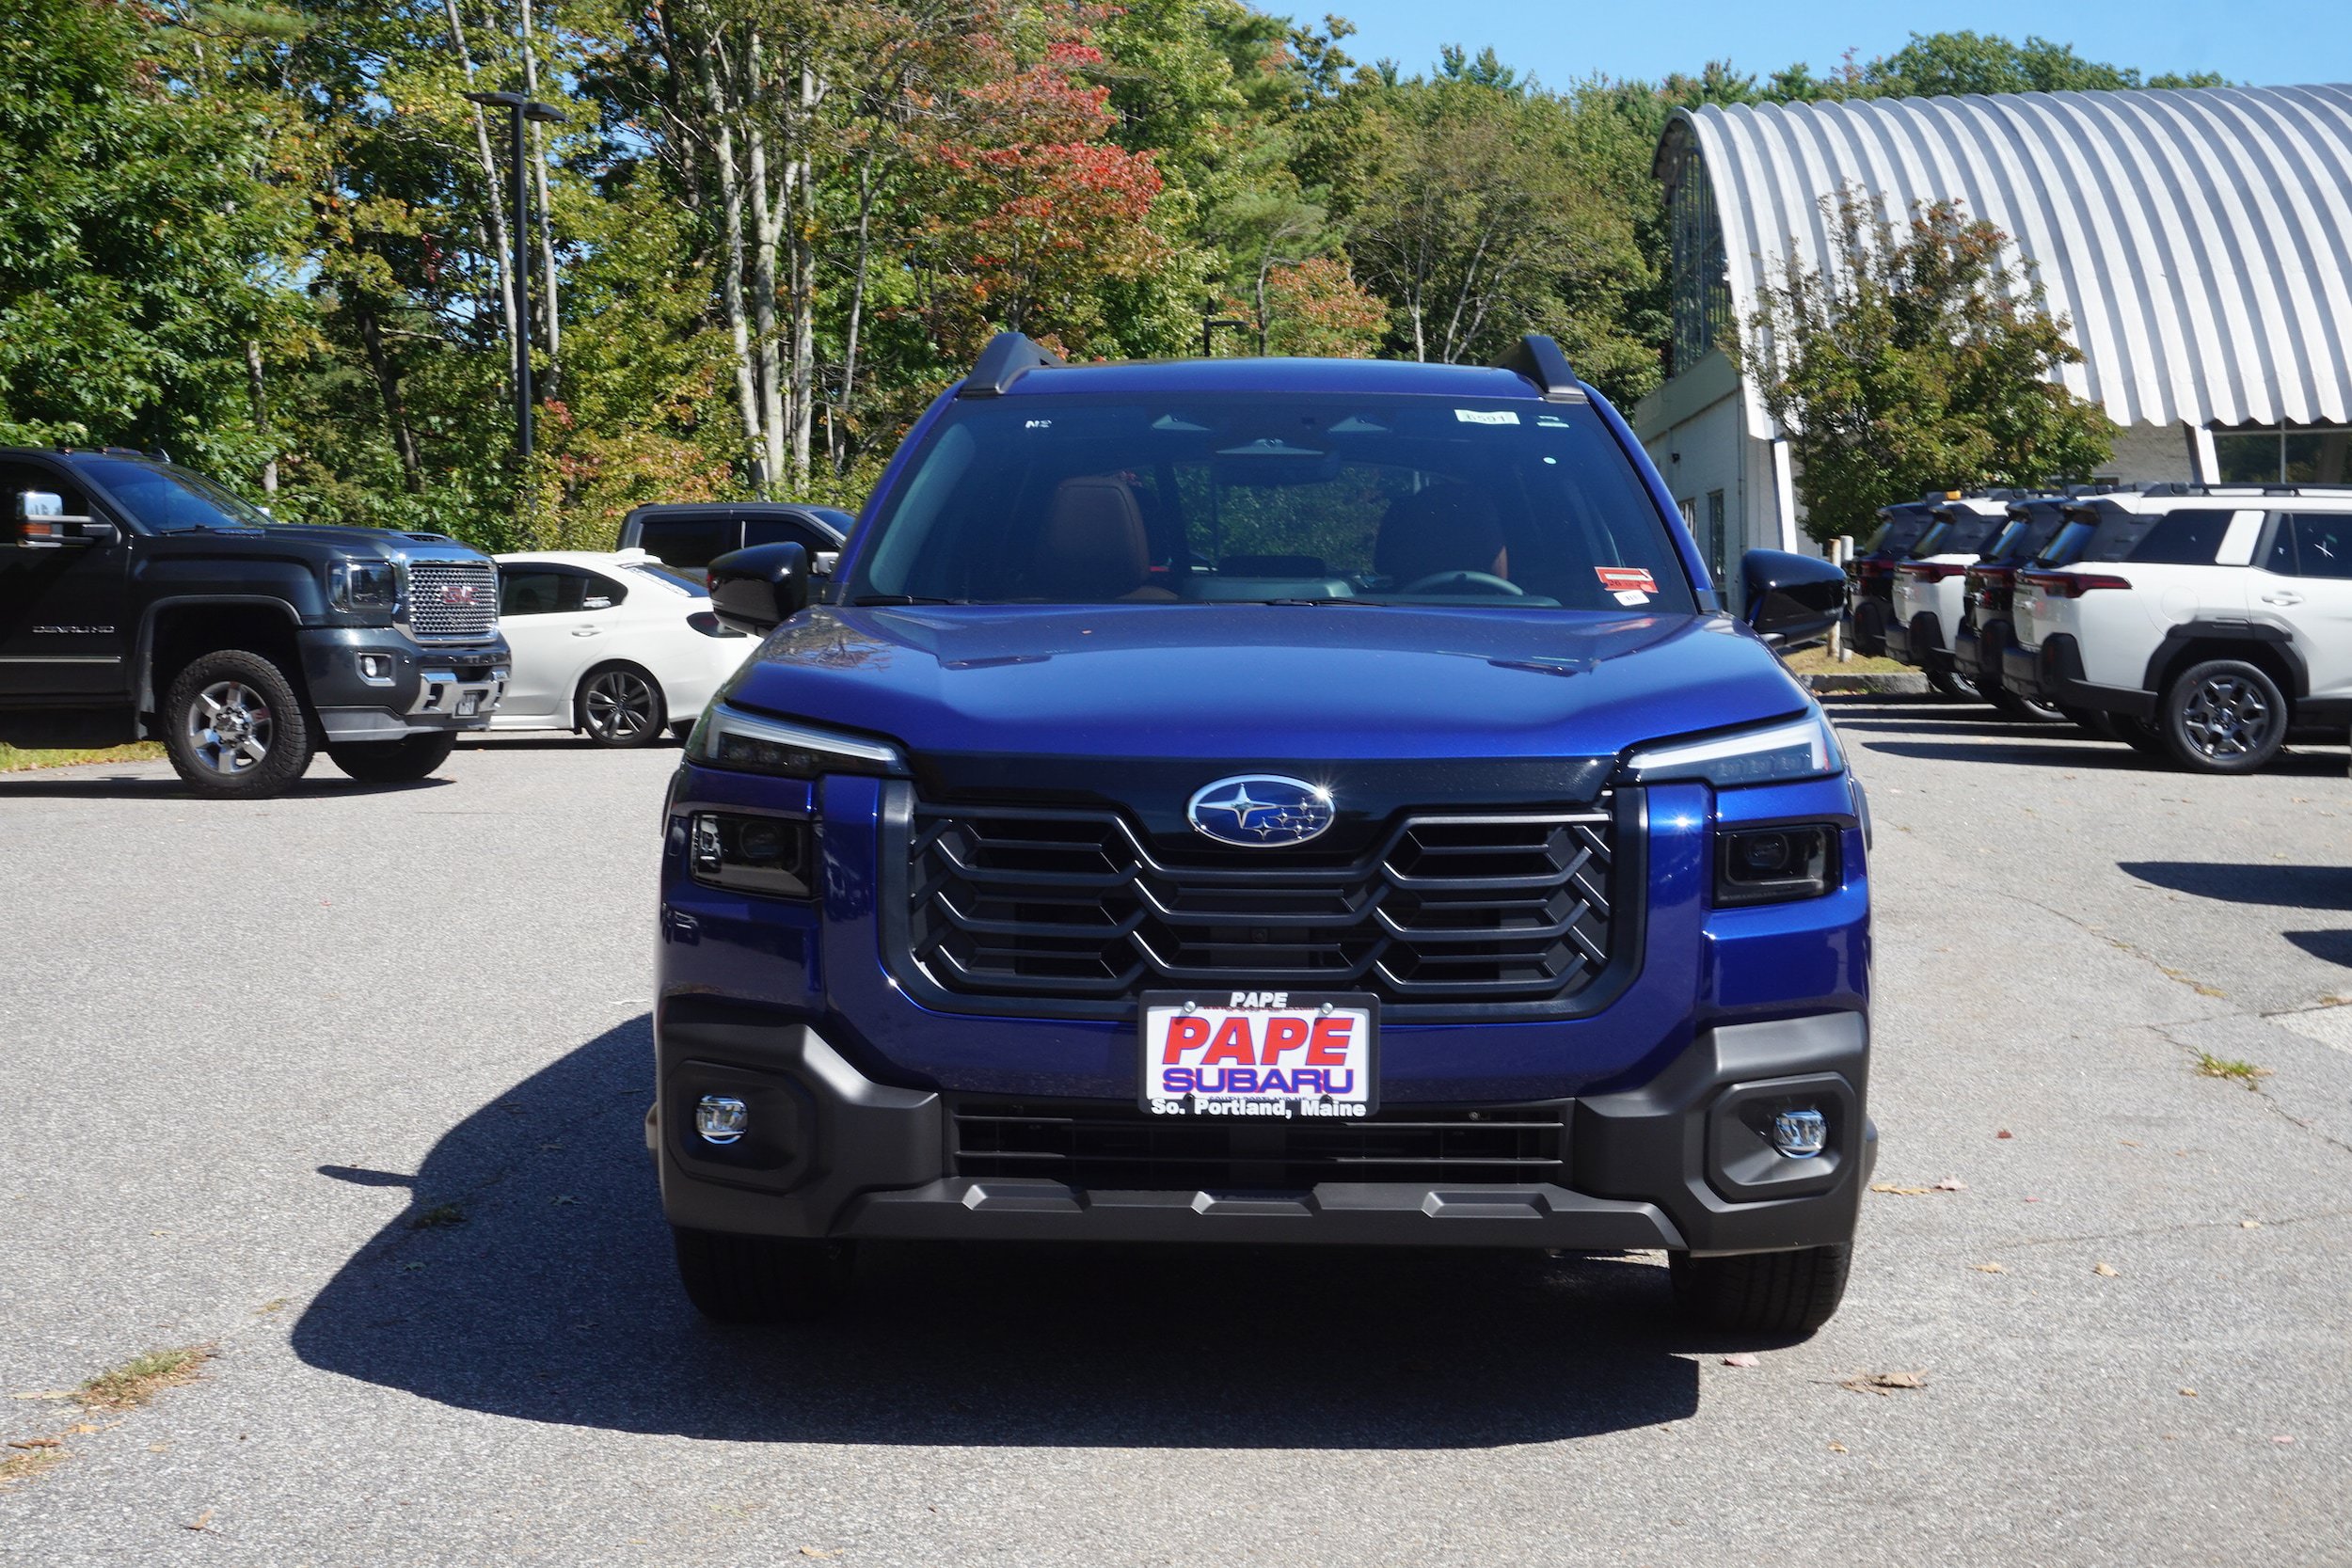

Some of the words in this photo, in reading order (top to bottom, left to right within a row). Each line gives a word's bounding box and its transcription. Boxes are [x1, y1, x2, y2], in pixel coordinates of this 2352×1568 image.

[1230, 991, 1288, 1008] PAPE
[1162, 1017, 1355, 1066] PAPE
[1162, 1068, 1354, 1094] SUBARU
[1151, 1099, 1185, 1116] So.
[1194, 1099, 1293, 1119] Portland,
[1300, 1100, 1366, 1117] Maine
